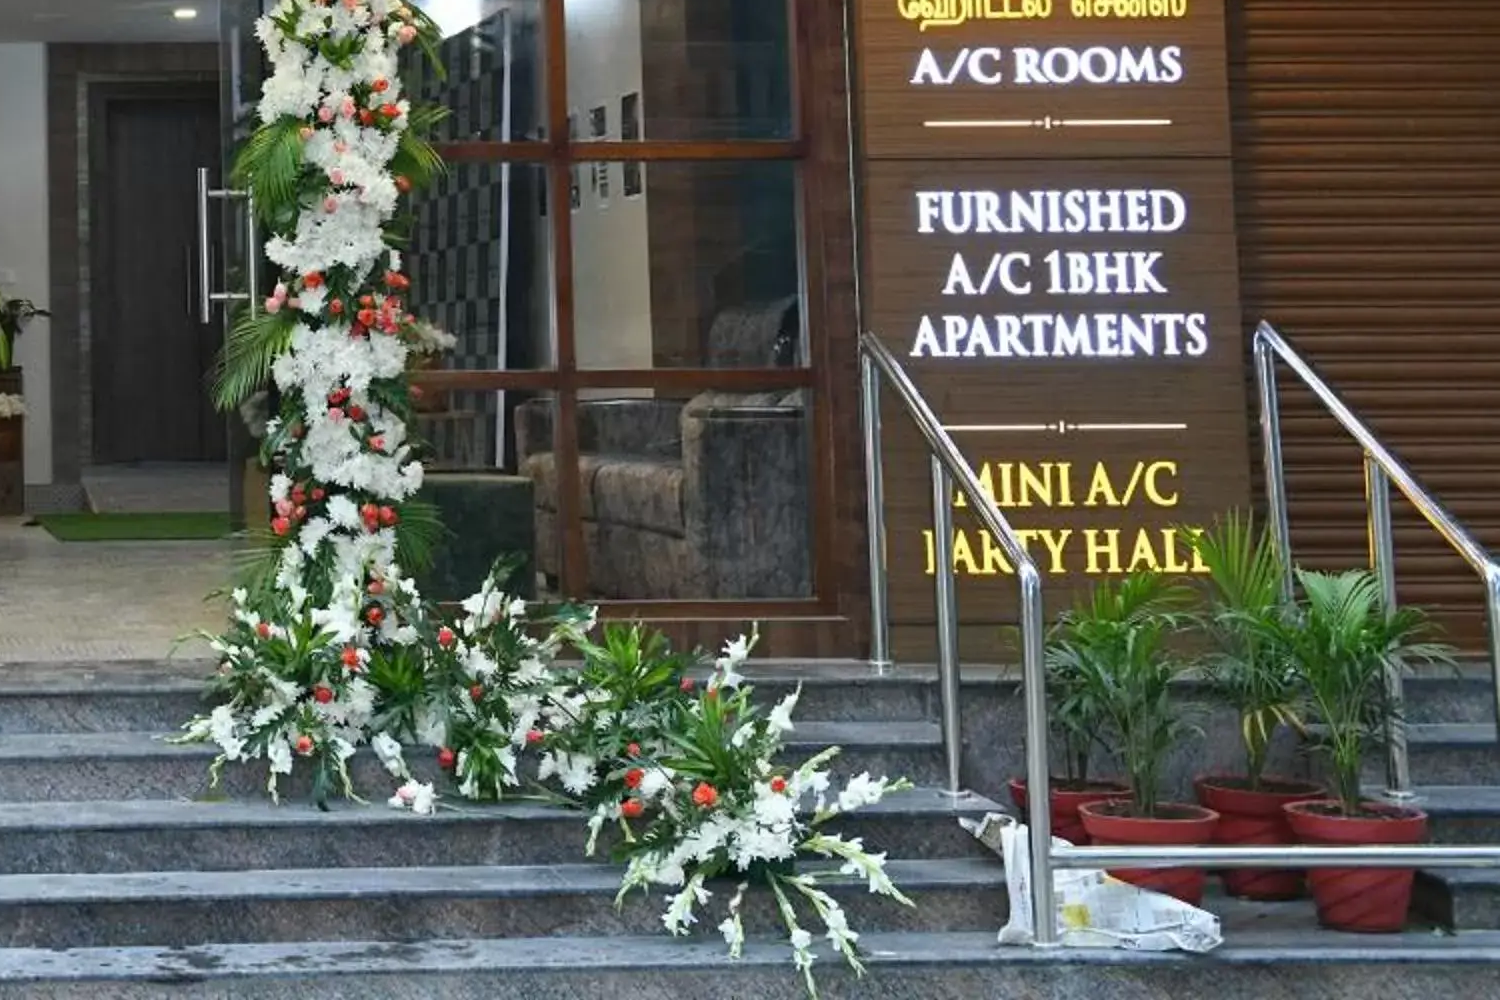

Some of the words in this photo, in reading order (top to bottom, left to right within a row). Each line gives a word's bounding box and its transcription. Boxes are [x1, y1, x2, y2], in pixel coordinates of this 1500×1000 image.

[910, 48, 1002, 84] A/C
[1012, 47, 1183, 84] ROOMS
[915, 189, 1187, 234] FURNISHED
[942, 252, 1031, 295] A/C
[1043, 250, 1168, 294] 1BHK
[909, 313, 1209, 357] APARTMENTS
[1084, 460, 1179, 508] A/C
